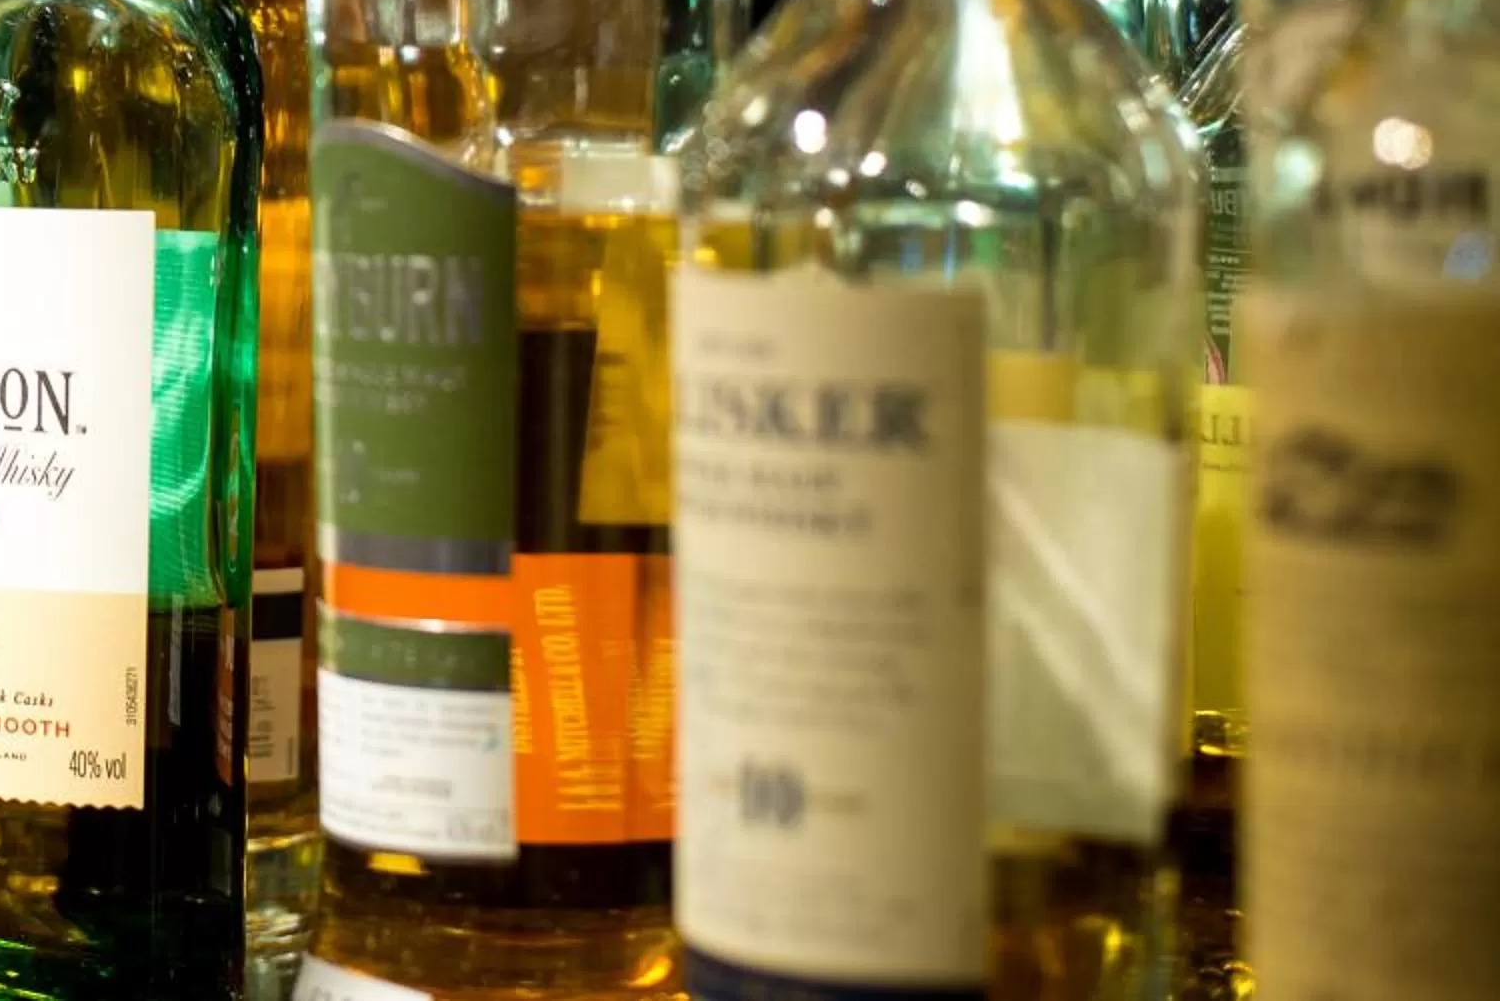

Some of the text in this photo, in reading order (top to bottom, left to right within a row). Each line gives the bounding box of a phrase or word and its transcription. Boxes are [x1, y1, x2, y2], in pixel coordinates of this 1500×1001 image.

[13, 691, 54, 708] Casks
[68, 749, 127, 780] 40% vol
